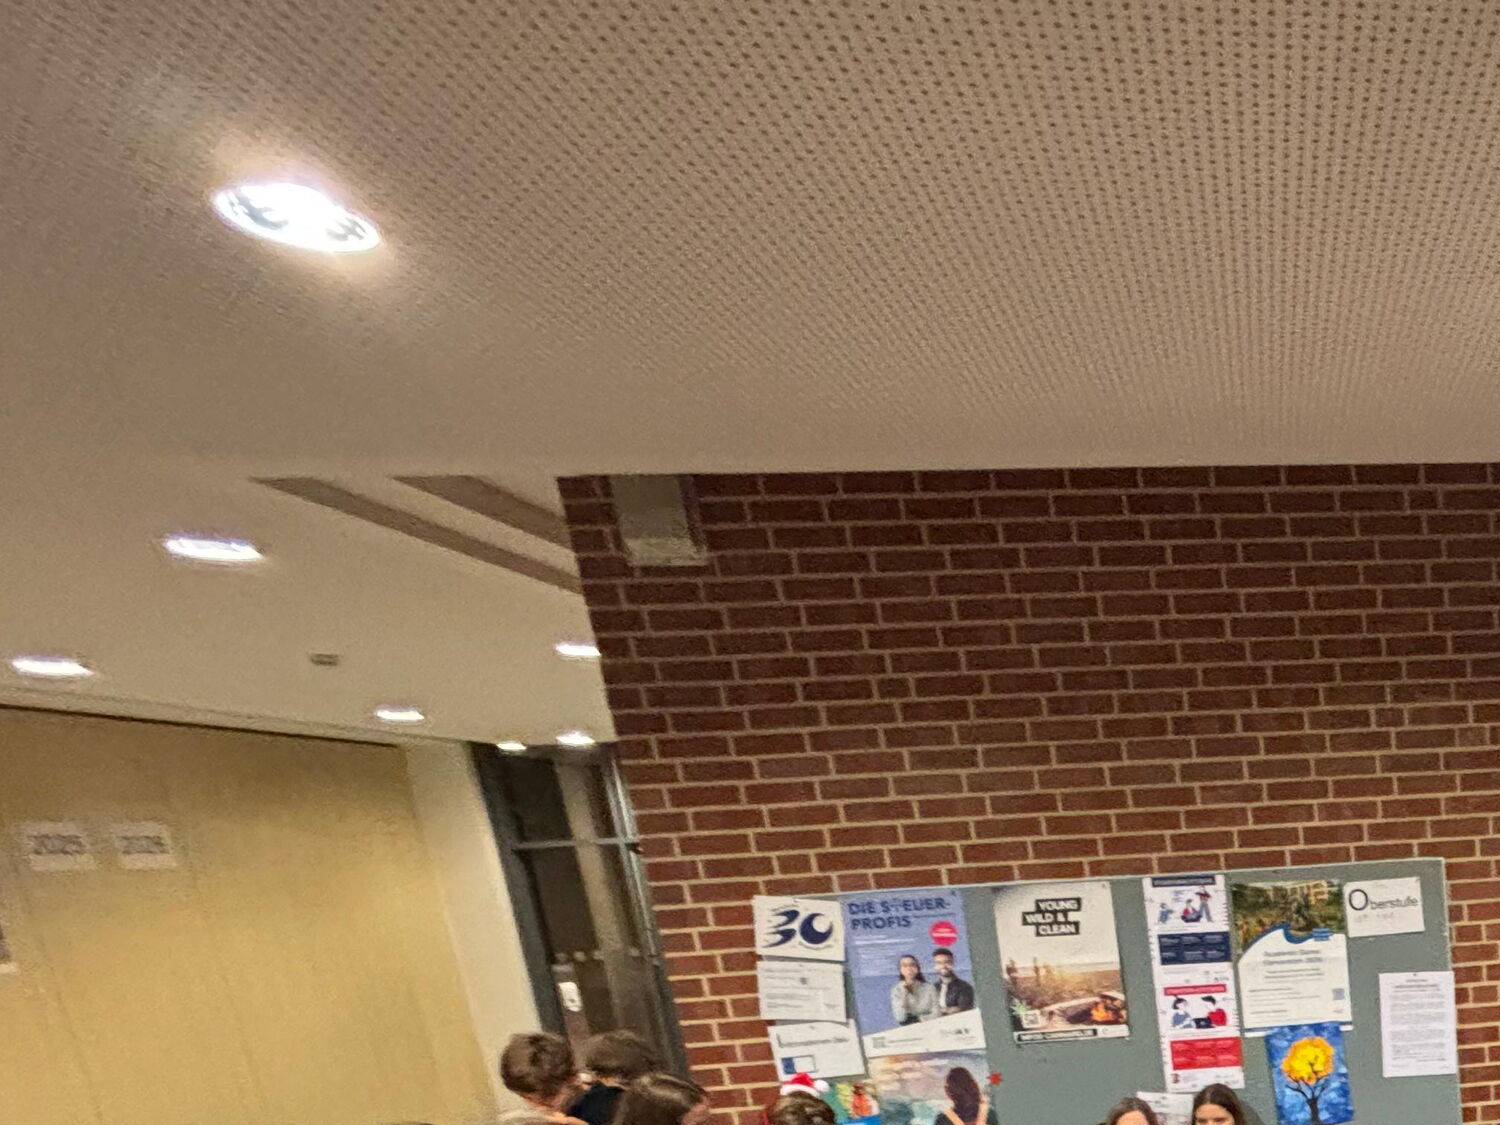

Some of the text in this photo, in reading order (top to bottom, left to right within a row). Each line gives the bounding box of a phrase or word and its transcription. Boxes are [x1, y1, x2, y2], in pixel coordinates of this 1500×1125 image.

[847, 897, 952, 915] DIE STEUER-
[1038, 900, 1079, 910] YOUNG
[850, 915, 912, 929] PROFIS
[1023, 914, 1054, 923] WILD
[1038, 925, 1076, 935] CLEAN
